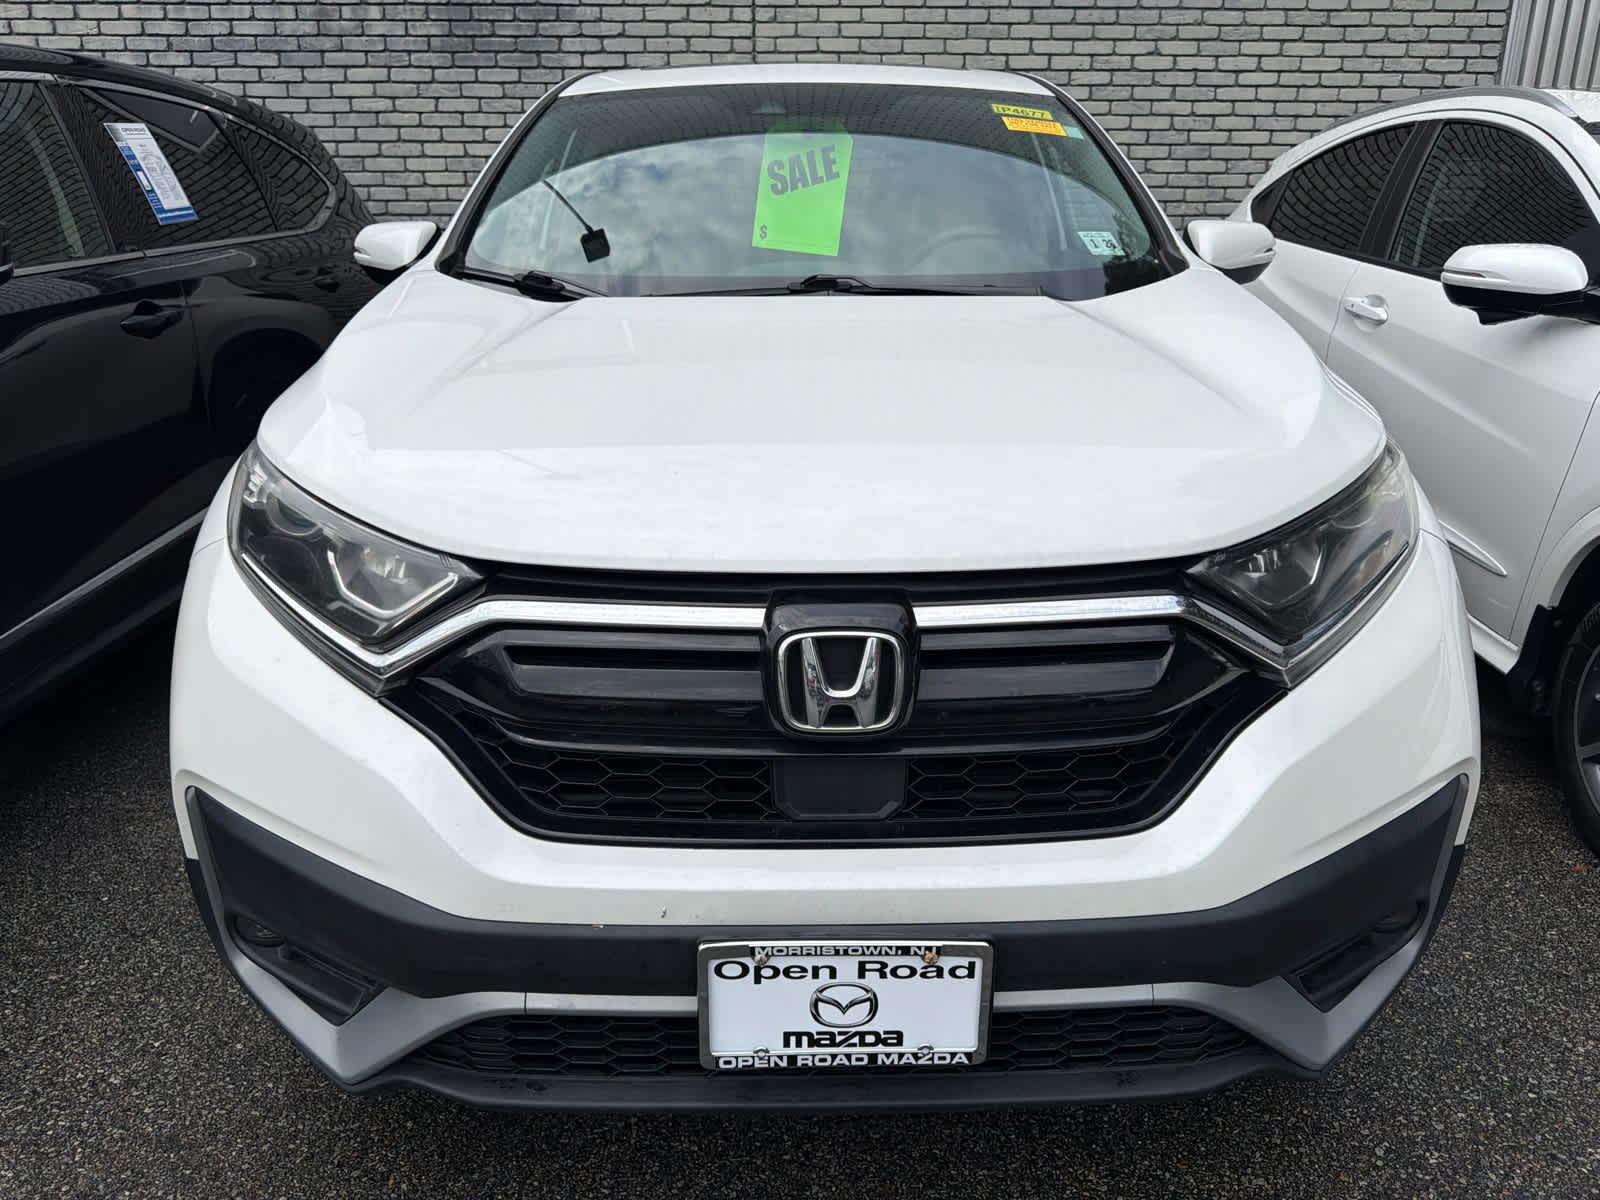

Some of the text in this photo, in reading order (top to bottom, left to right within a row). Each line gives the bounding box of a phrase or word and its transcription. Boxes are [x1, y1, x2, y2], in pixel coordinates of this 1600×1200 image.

[767, 144, 841, 196] SALE
[759, 224, 768, 240] $
[754, 945, 901, 957] MORRISTOWN,
[713, 960, 976, 984] Open Road
[718, 1052, 970, 1069] OPEN ROAD MAZDA
